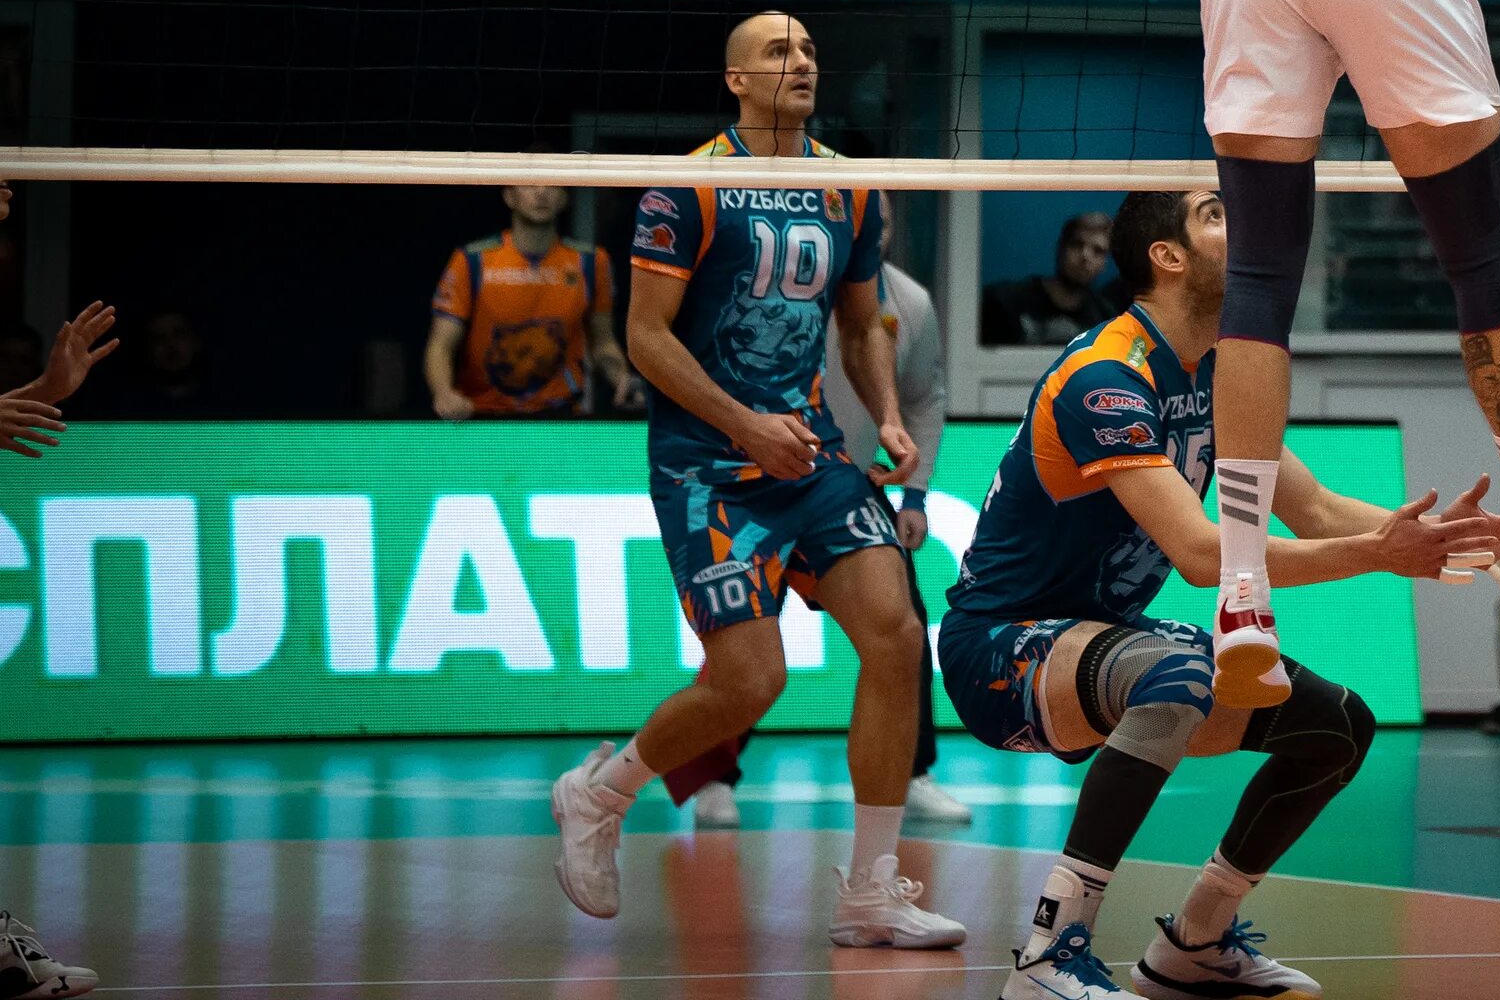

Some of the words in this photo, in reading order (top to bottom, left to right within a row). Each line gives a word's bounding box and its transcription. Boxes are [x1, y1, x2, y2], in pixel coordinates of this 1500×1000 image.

[749, 216, 834, 301] 10
[0, 491, 982, 676] ПЛАТ
[706, 578, 749, 616] 10
